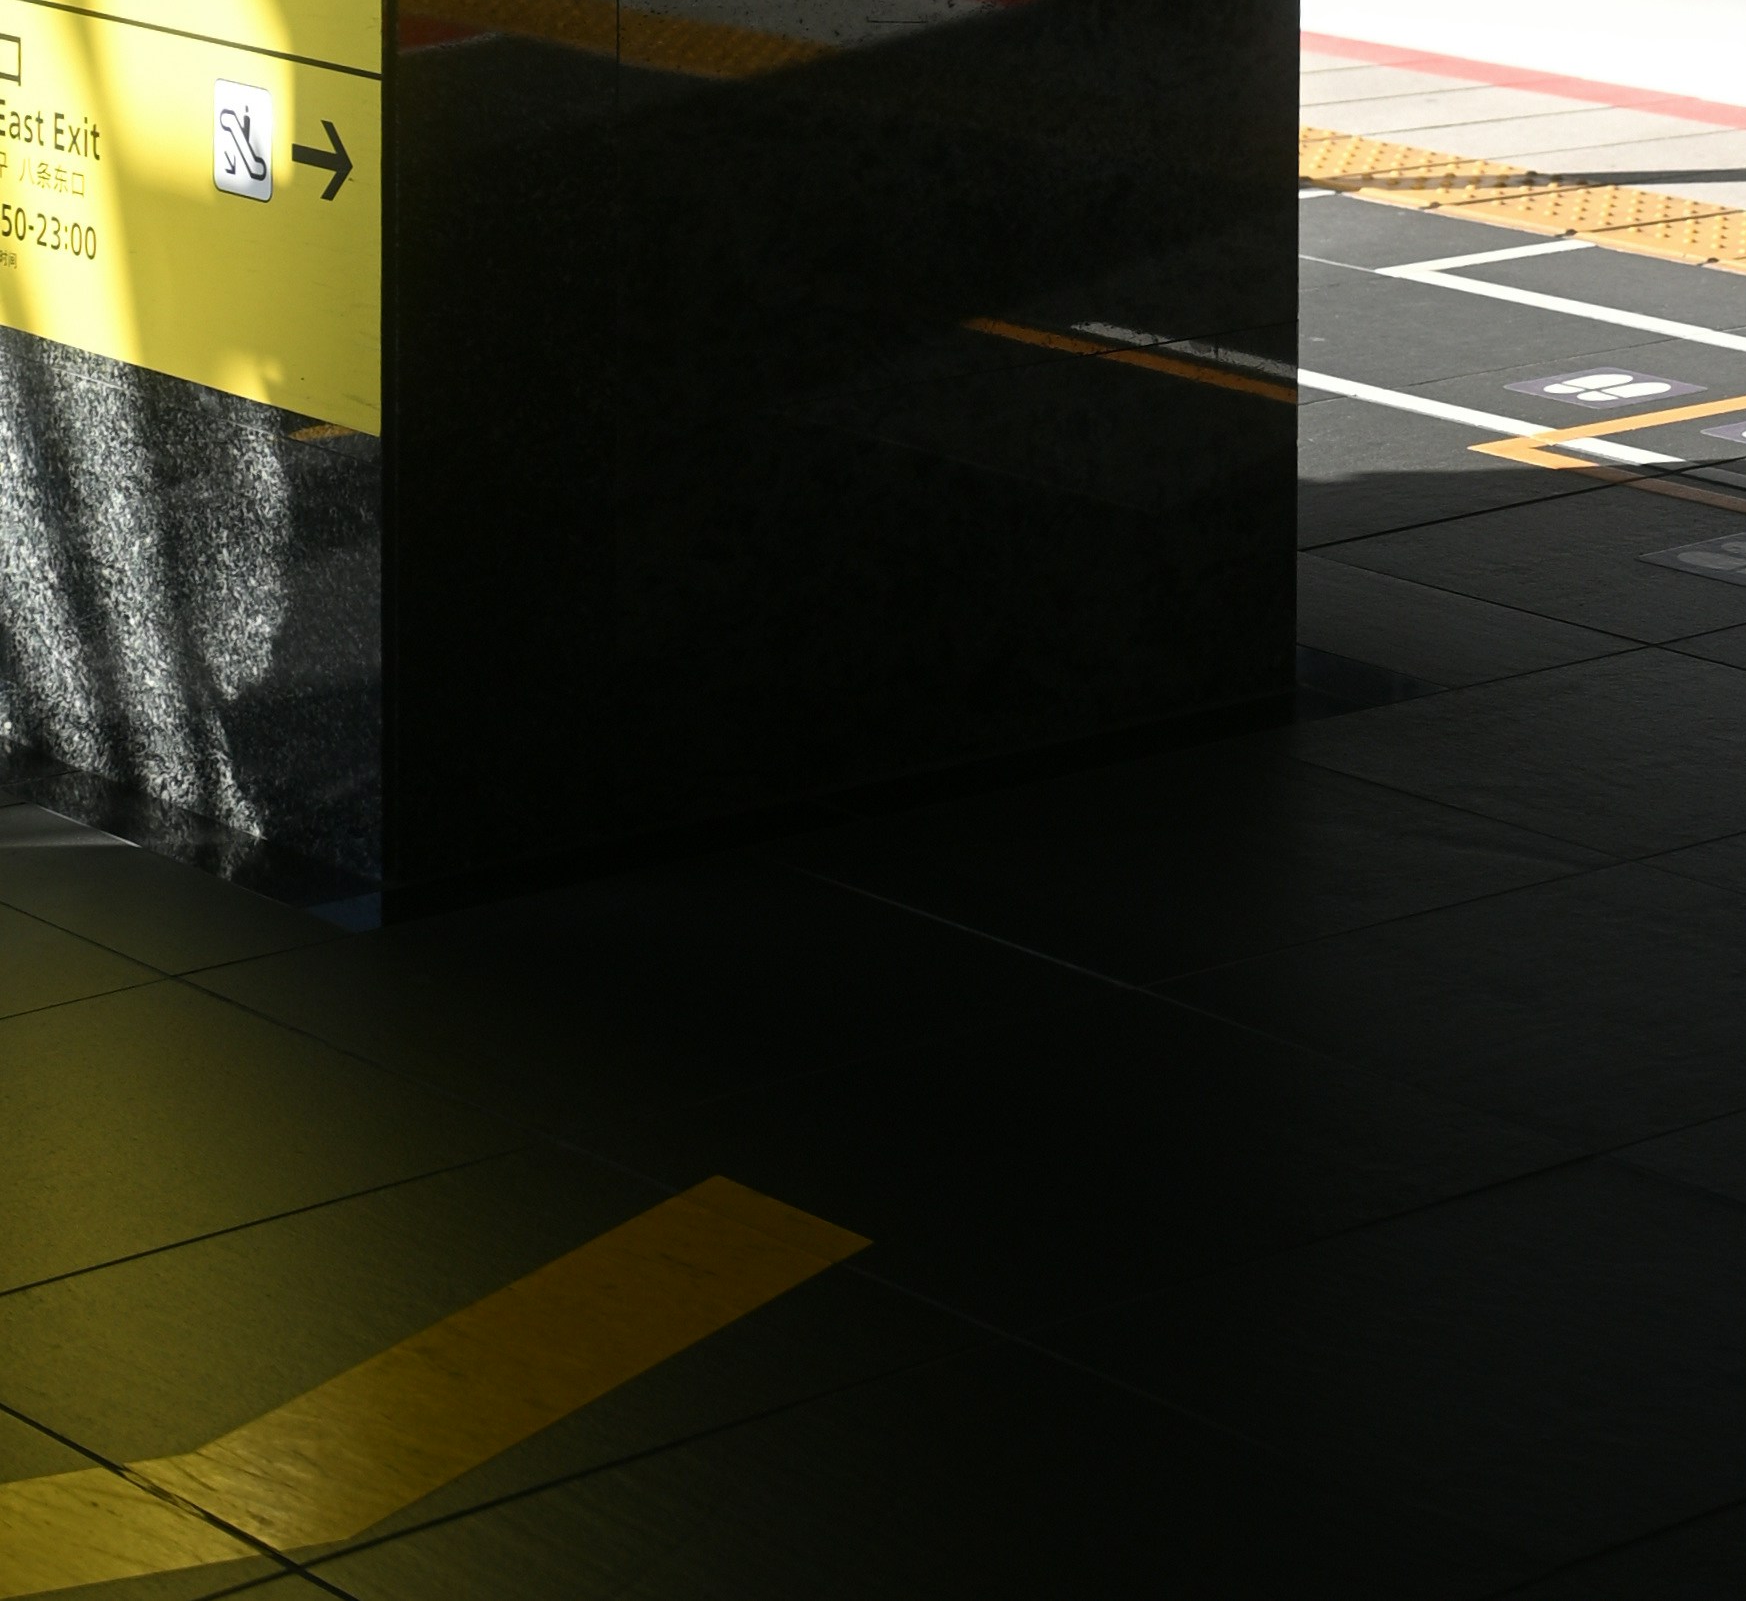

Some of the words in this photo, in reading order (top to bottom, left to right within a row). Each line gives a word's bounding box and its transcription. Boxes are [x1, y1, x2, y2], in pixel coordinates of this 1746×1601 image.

[54, 112, 101, 161] Exit
[19, 157, 85, 198] 八条东口
[1, 203, 97, 261] 50-23:00
